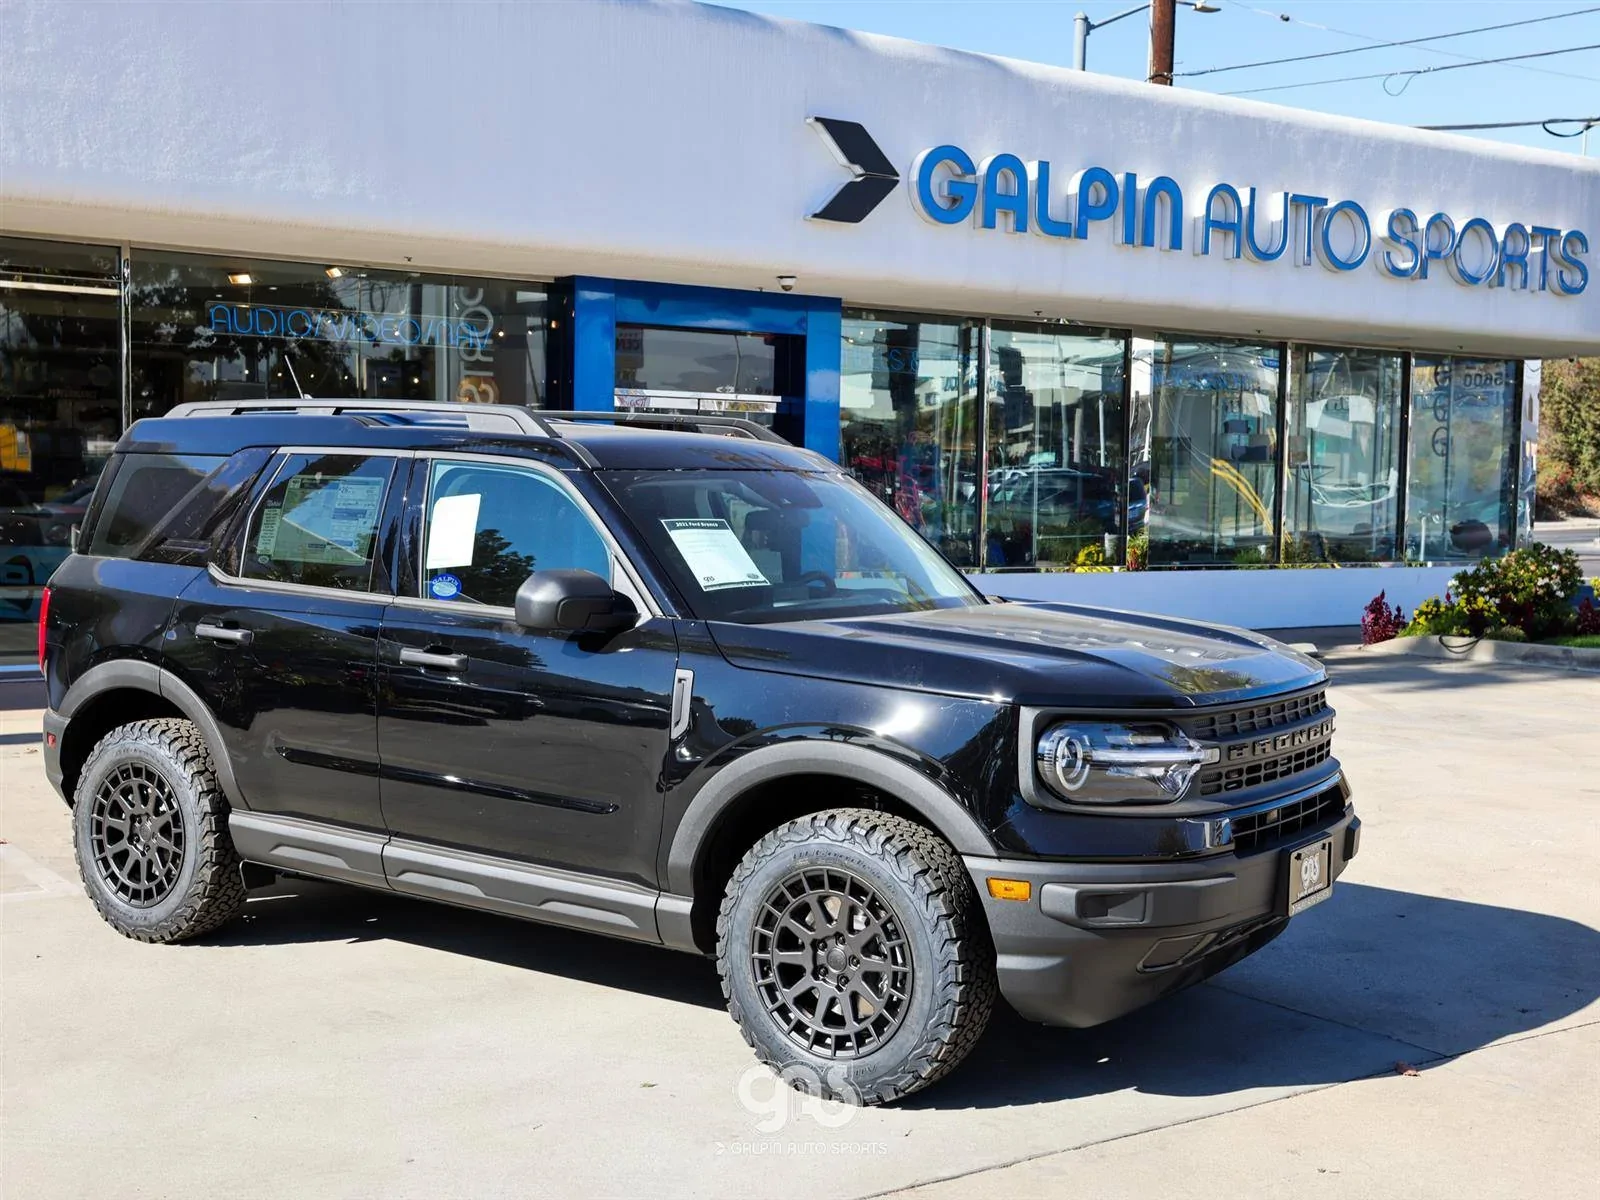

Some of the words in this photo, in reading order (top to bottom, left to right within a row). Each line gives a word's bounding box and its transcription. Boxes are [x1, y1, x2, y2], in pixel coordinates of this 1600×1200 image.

[911, 144, 1183, 251] GALPIN
[1196, 183, 1371, 273] AUTO
[1379, 207, 1590, 298] SPORTS
[1228, 718, 1337, 761] BRONCO
